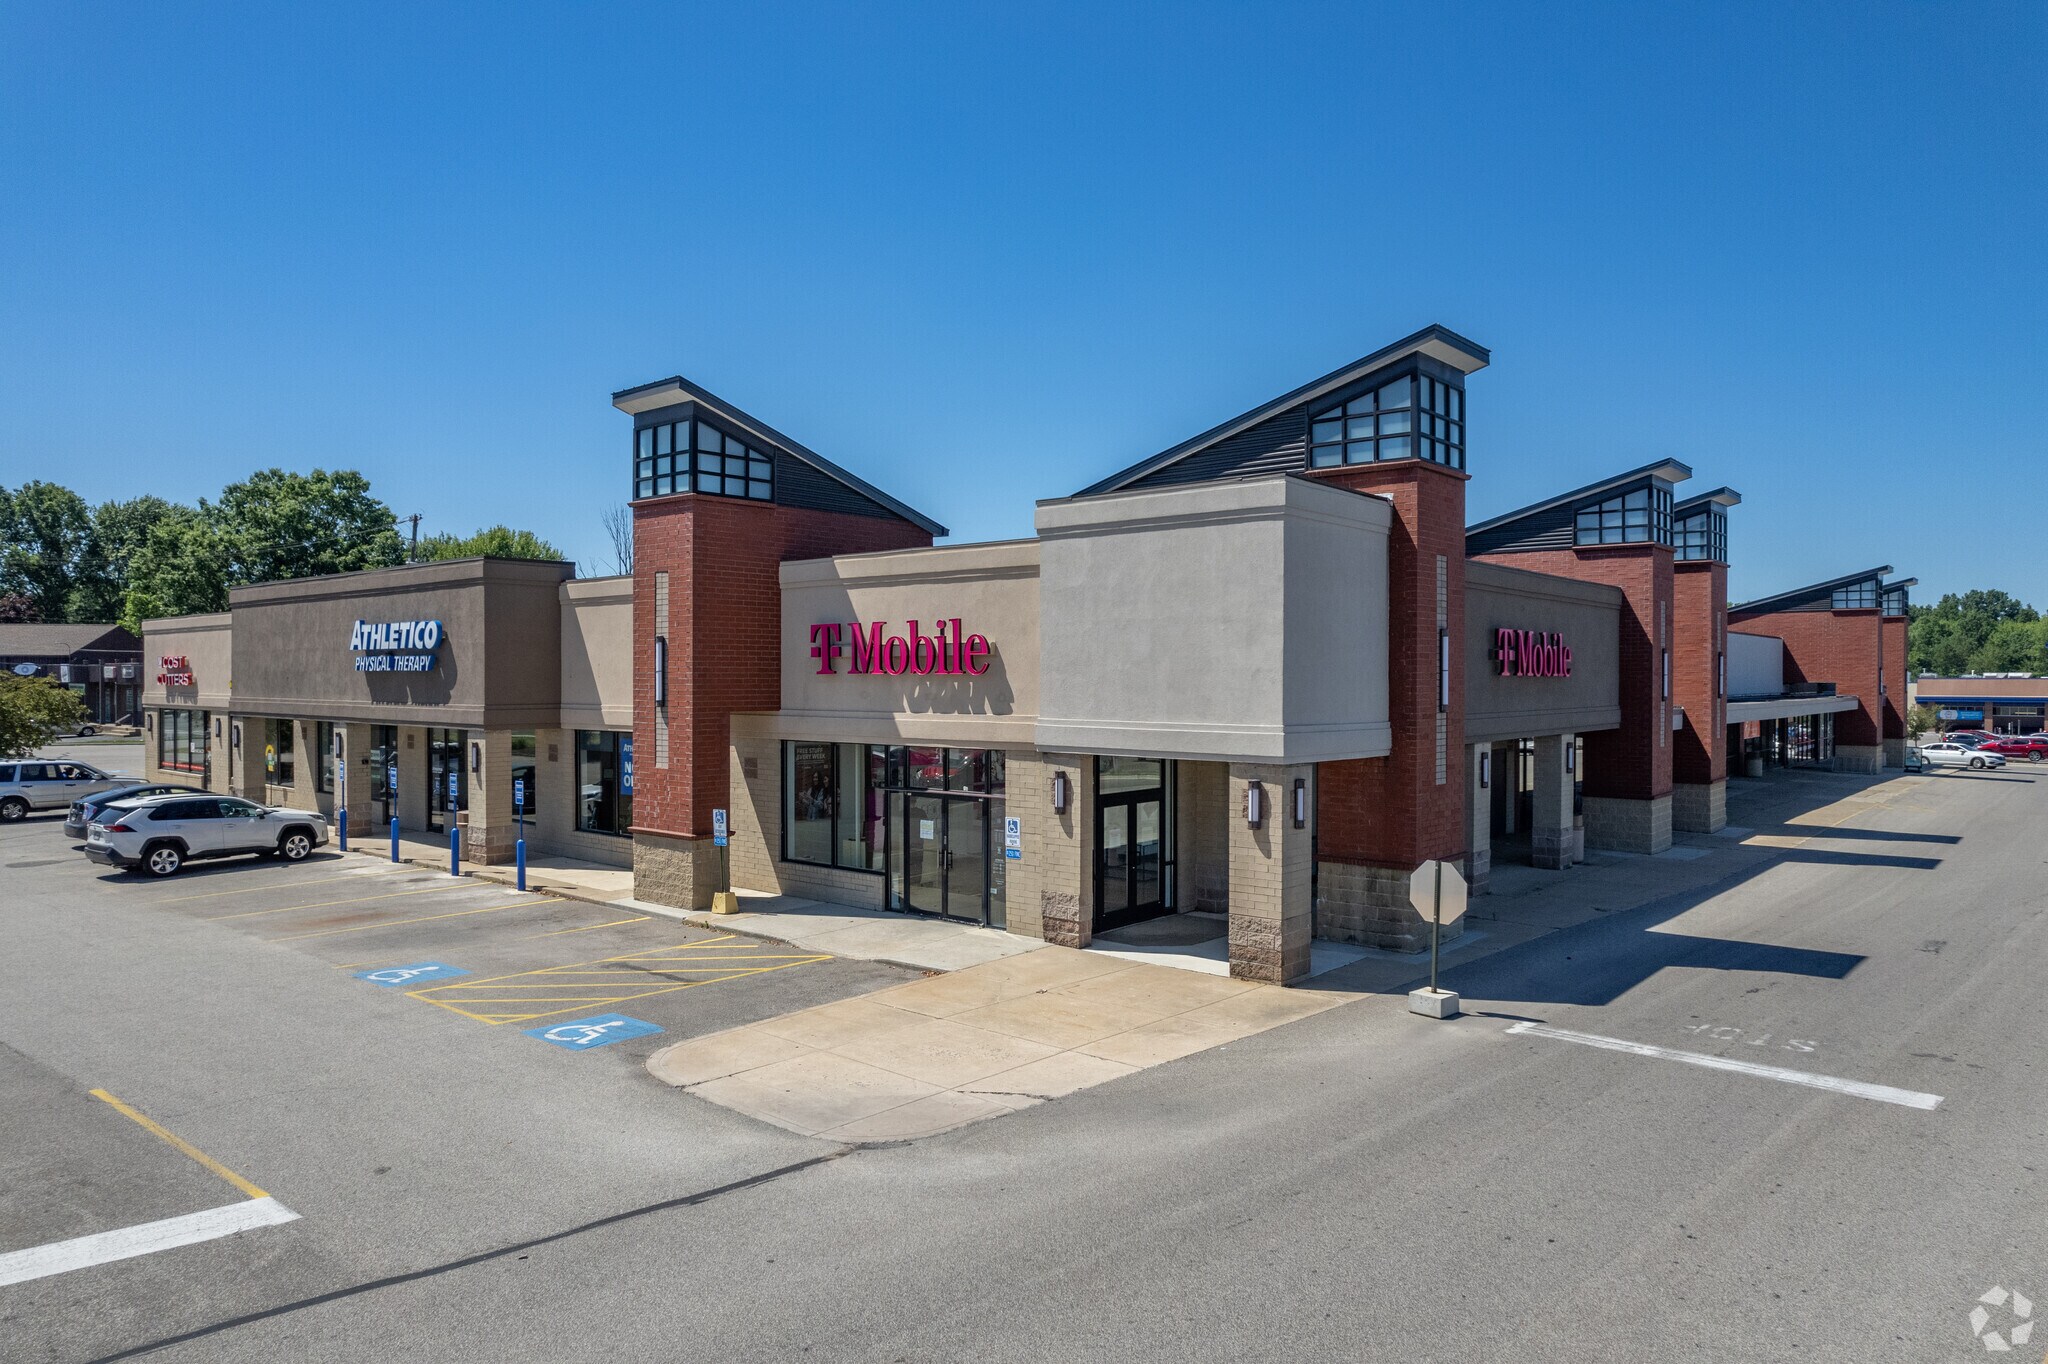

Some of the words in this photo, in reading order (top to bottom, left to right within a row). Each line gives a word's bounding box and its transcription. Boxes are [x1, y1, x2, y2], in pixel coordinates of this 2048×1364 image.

[350, 619, 442, 651] ATHLETICO
[847, 618, 991, 676] Mobile
[162, 656, 184, 669] COST
[354, 655, 391, 672] PHYSICAL
[393, 655, 432, 672] THERAPY
[1517, 629, 1572, 677] Mobile
[157, 673, 190, 686] CUTTERS
